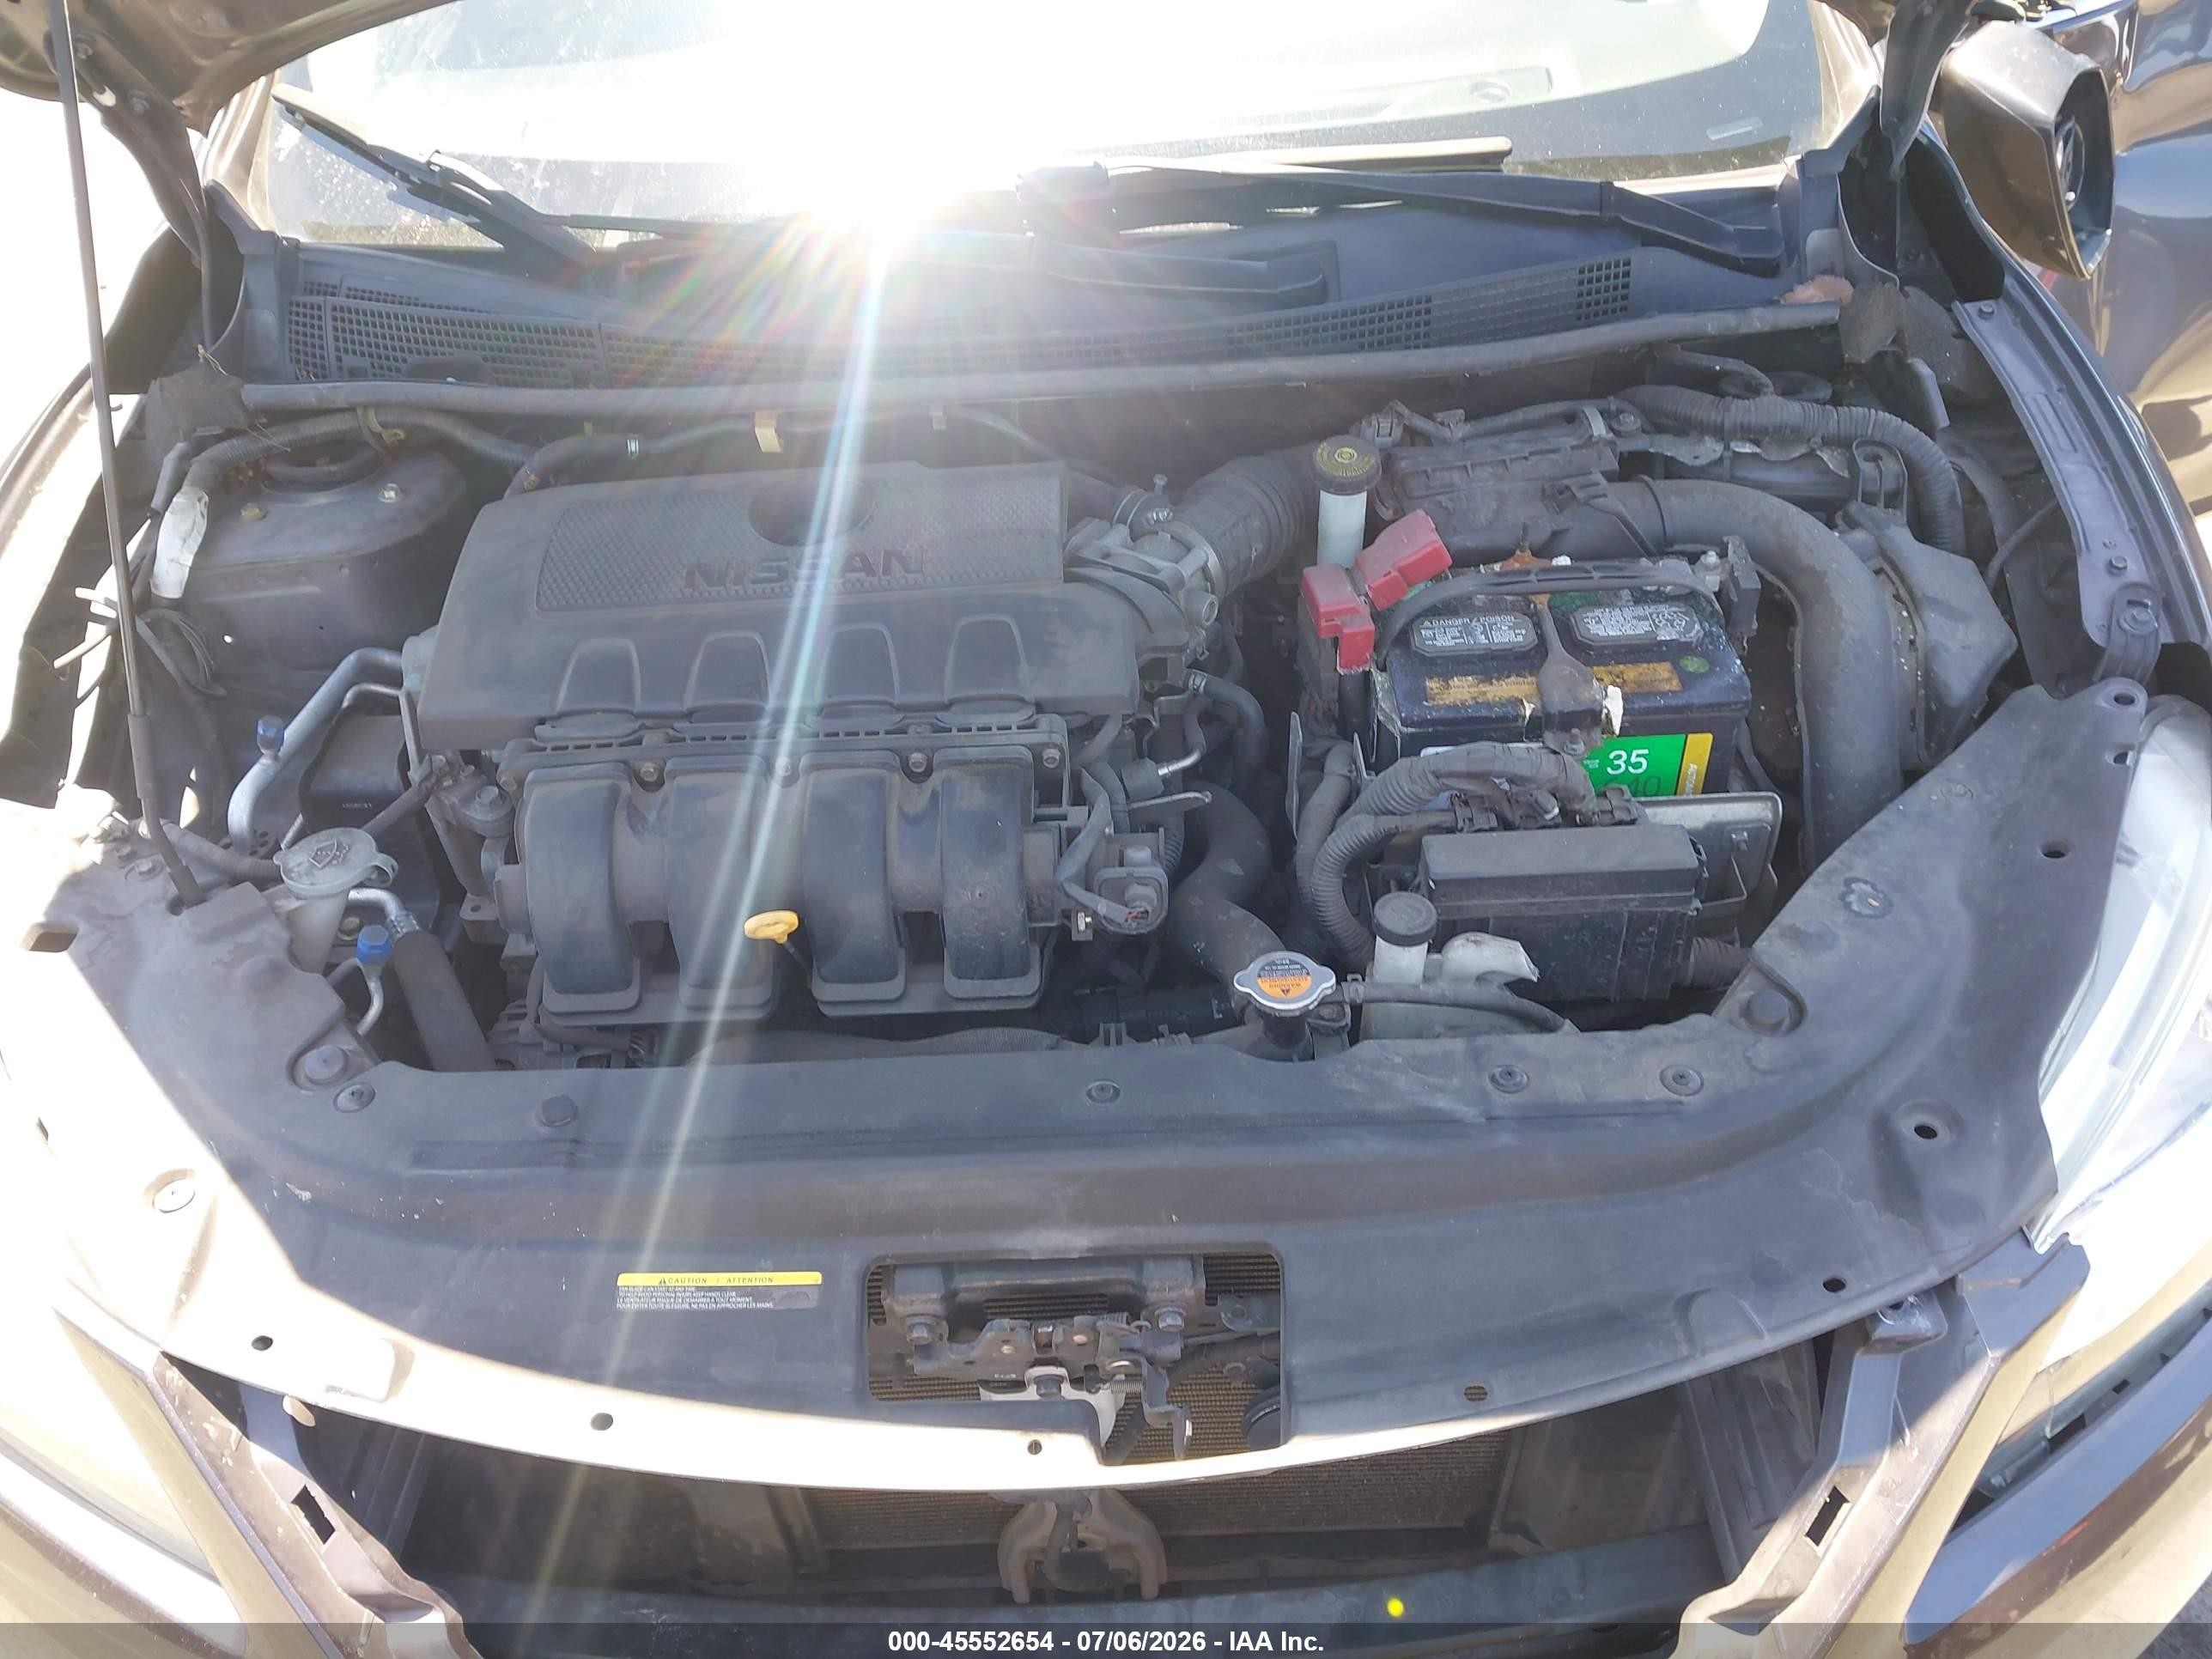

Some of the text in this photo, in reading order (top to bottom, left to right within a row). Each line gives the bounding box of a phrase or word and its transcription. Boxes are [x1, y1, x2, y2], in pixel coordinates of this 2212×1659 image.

[684, 548, 926, 590] NISSAN
[1432, 617, 1470, 626] DANGER
[1480, 615, 1514, 623] POISON
[1607, 749, 1649, 775] 35
